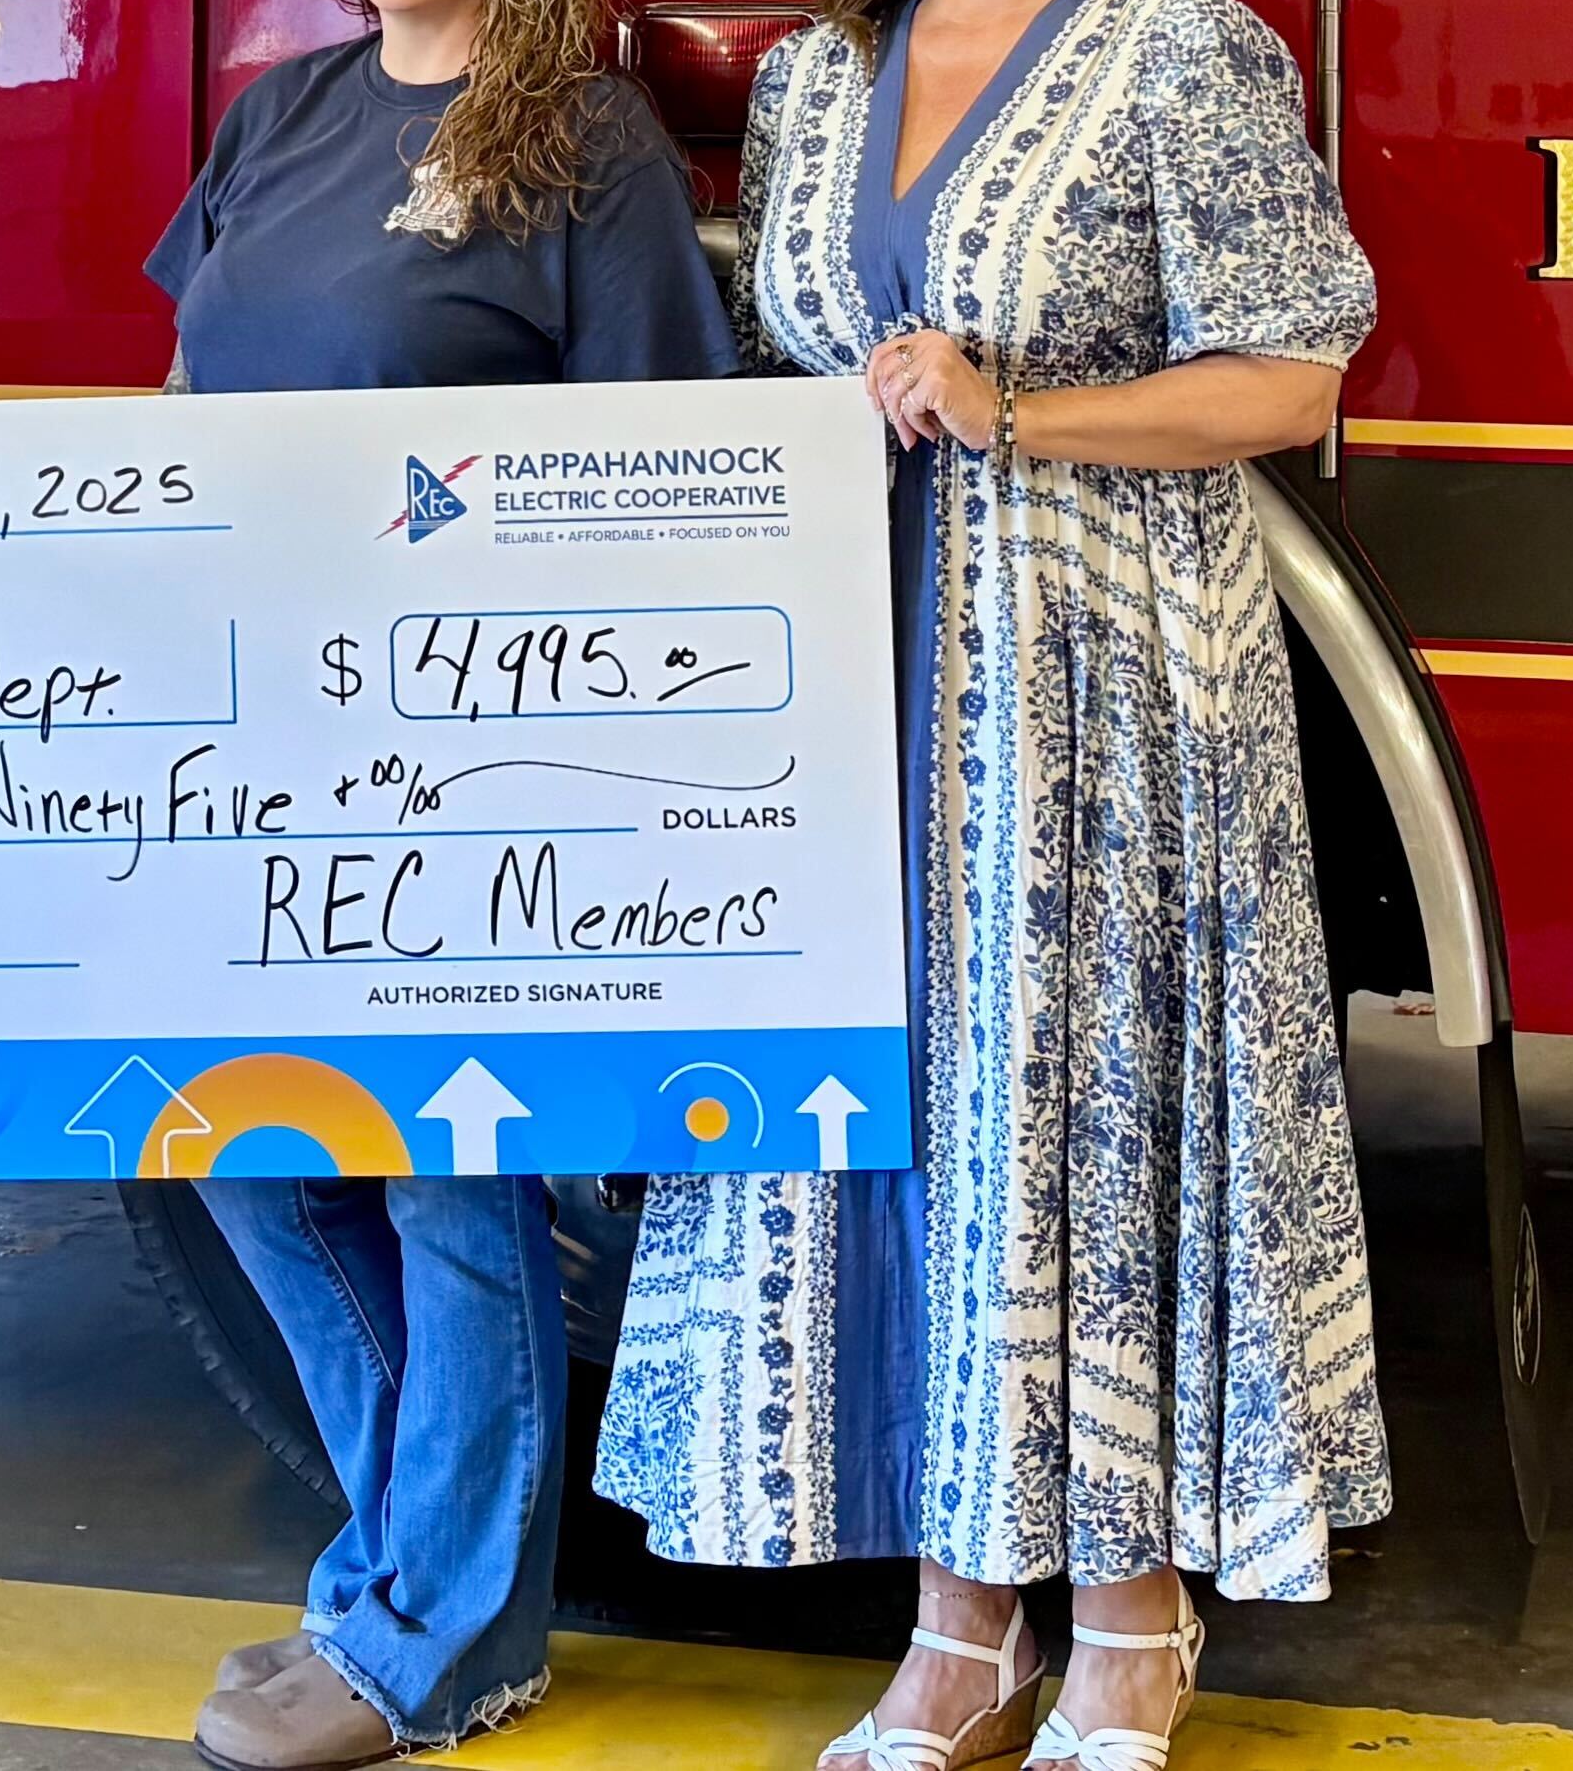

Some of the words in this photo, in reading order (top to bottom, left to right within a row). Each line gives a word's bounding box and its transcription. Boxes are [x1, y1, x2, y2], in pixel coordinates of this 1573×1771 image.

[494, 445, 784, 480] RAPPAHANNOCK
[31, 464, 193, 519] 2025
[494, 489, 607, 512] ELECTRIC
[614, 485, 786, 509] COOPERATIVE
[495, 531, 554, 545] RELIABLE
[568, 529, 654, 543] AFFORDABLE
[669, 527, 731, 540] FOCUSED
[736, 525, 757, 538] ON
[761, 525, 790, 538] YOU
[321, 633, 362, 707] $
[167, 743, 293, 843] Five
[662, 807, 797, 830] DOLLARS
[260, 848, 444, 968] REC
[490, 840, 778, 953] Members
[367, 984, 520, 1007] AUTHORIZED
[527, 982, 663, 1004] SIGNATURE
